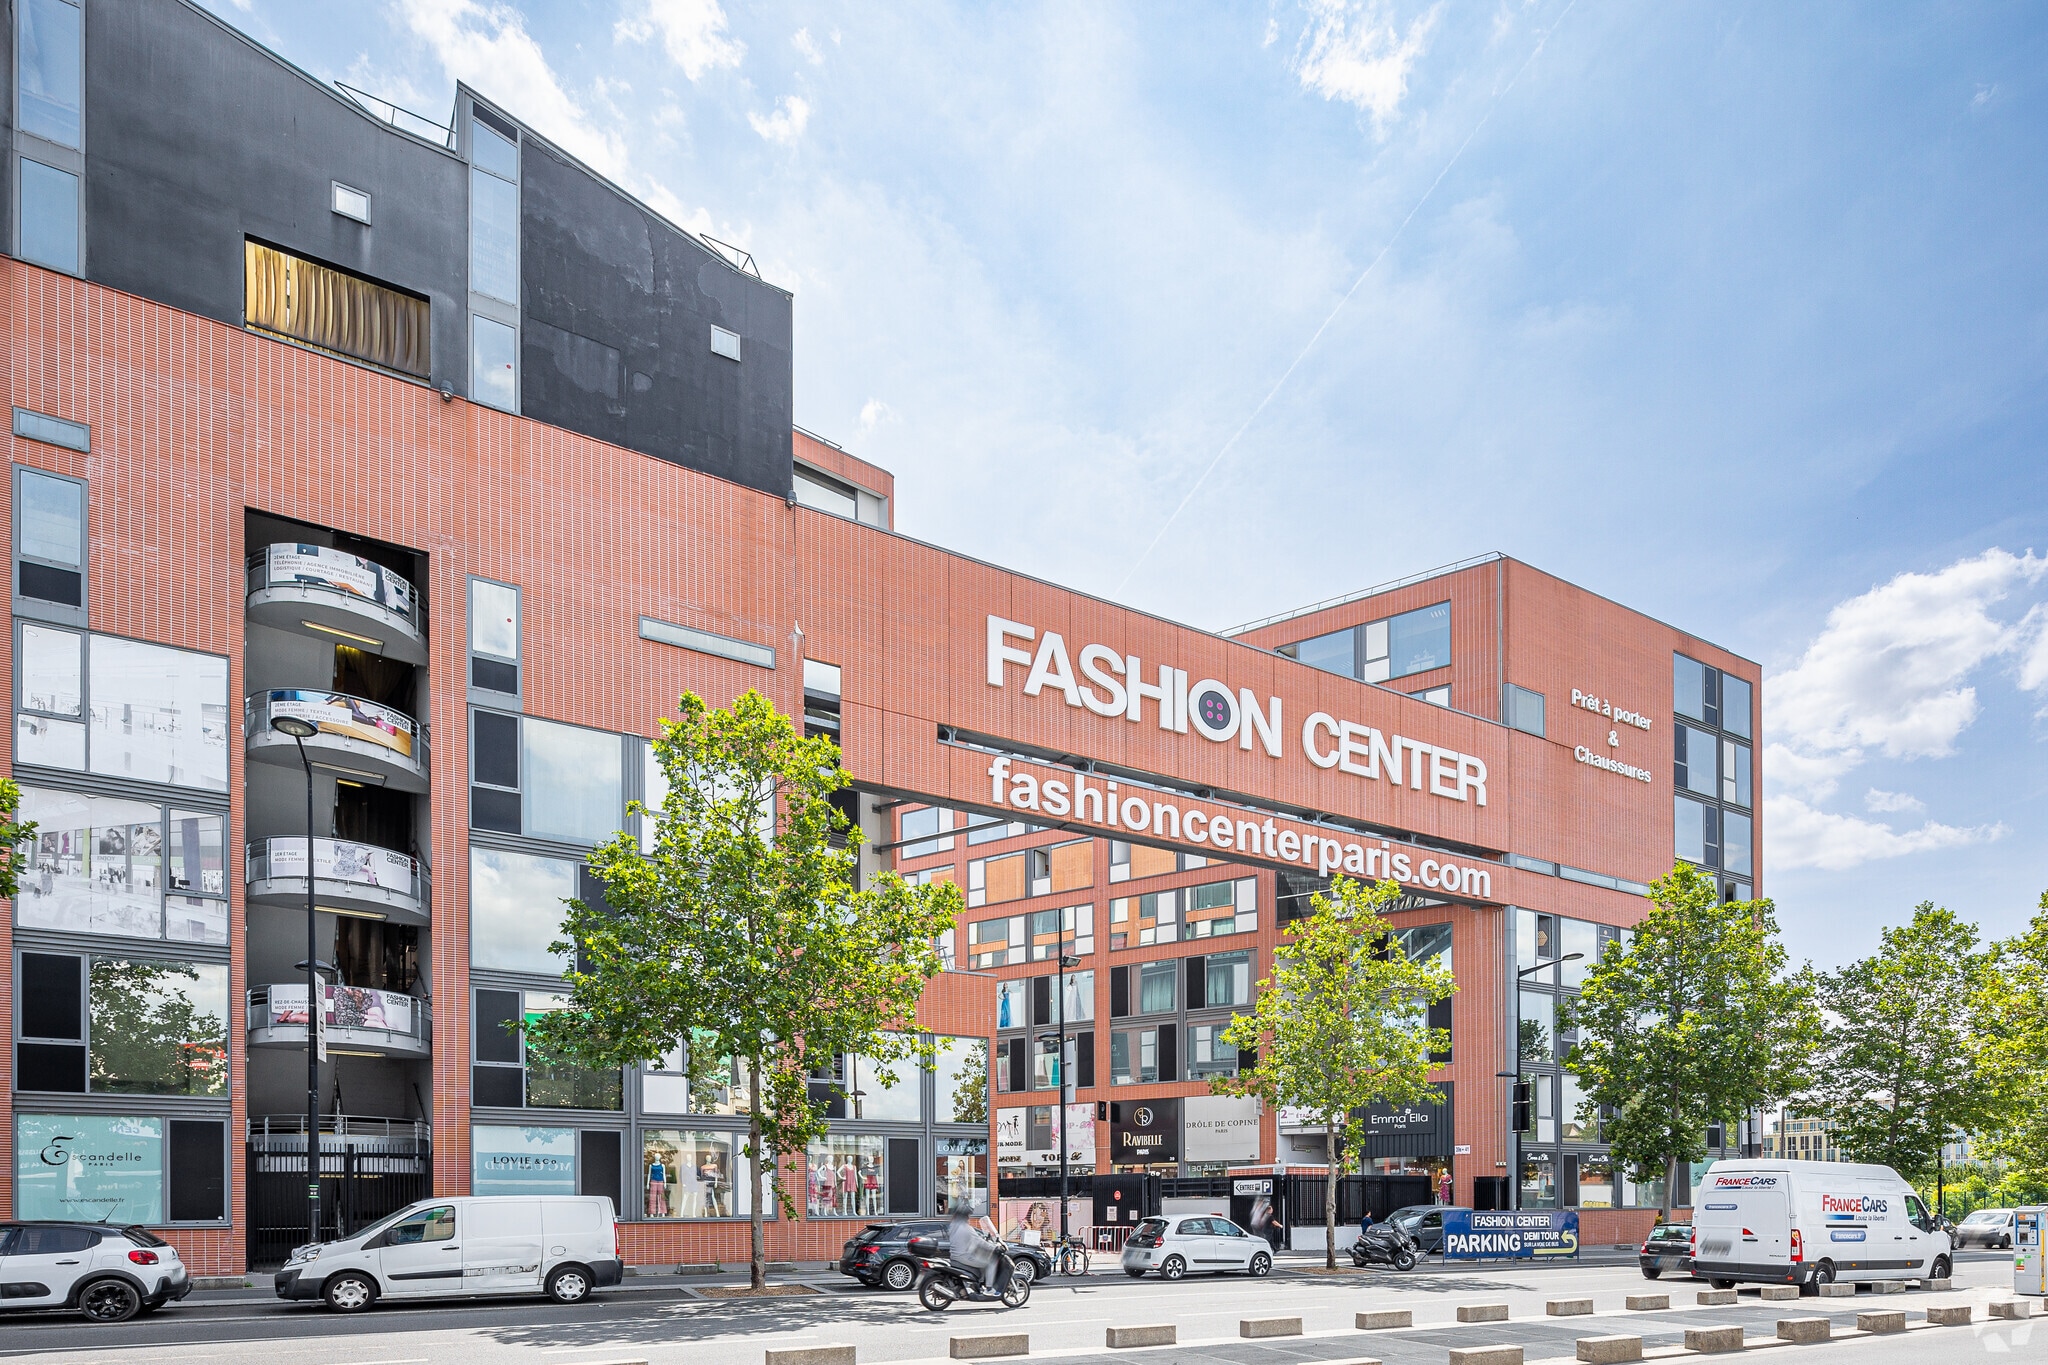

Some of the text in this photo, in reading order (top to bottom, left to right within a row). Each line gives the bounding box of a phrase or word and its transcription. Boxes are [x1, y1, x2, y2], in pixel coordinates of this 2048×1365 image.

[305, 568, 333, 576] COURTAGE
[986, 614, 1283, 759] FASHION
[1571, 688, 1652, 730] Prêt à porter
[316, 716, 349, 724] ACCESSOIRE
[1607, 730, 1619, 747] &
[1302, 711, 1488, 807] CENTER
[1574, 745, 1652, 783] Chaussures
[988, 755, 1491, 898] fashioncenterparis.com
[387, 852, 408, 863] FASHION
[387, 993, 408, 1002] FASHION
[387, 999, 408, 1008] CENTER
[1280, 1109, 1288, 1119] 2
[1371, 1113, 1428, 1124] Emma Ella
[1186, 1119, 1213, 1128] DRÔLE
[1227, 1119, 1258, 1127] COPINE
[1123, 1131, 1163, 1147] RAVIBELLE
[40, 1136, 142, 1166] Escandelle
[493, 1156, 531, 1165] LOVIE
[1263, 1181, 1271, 1193] P
[1474, 1215, 1550, 1227] FASHION CENTER
[1523, 1231, 1560, 1241] DEMI TOUR
[1447, 1233, 1521, 1253] PARKING
